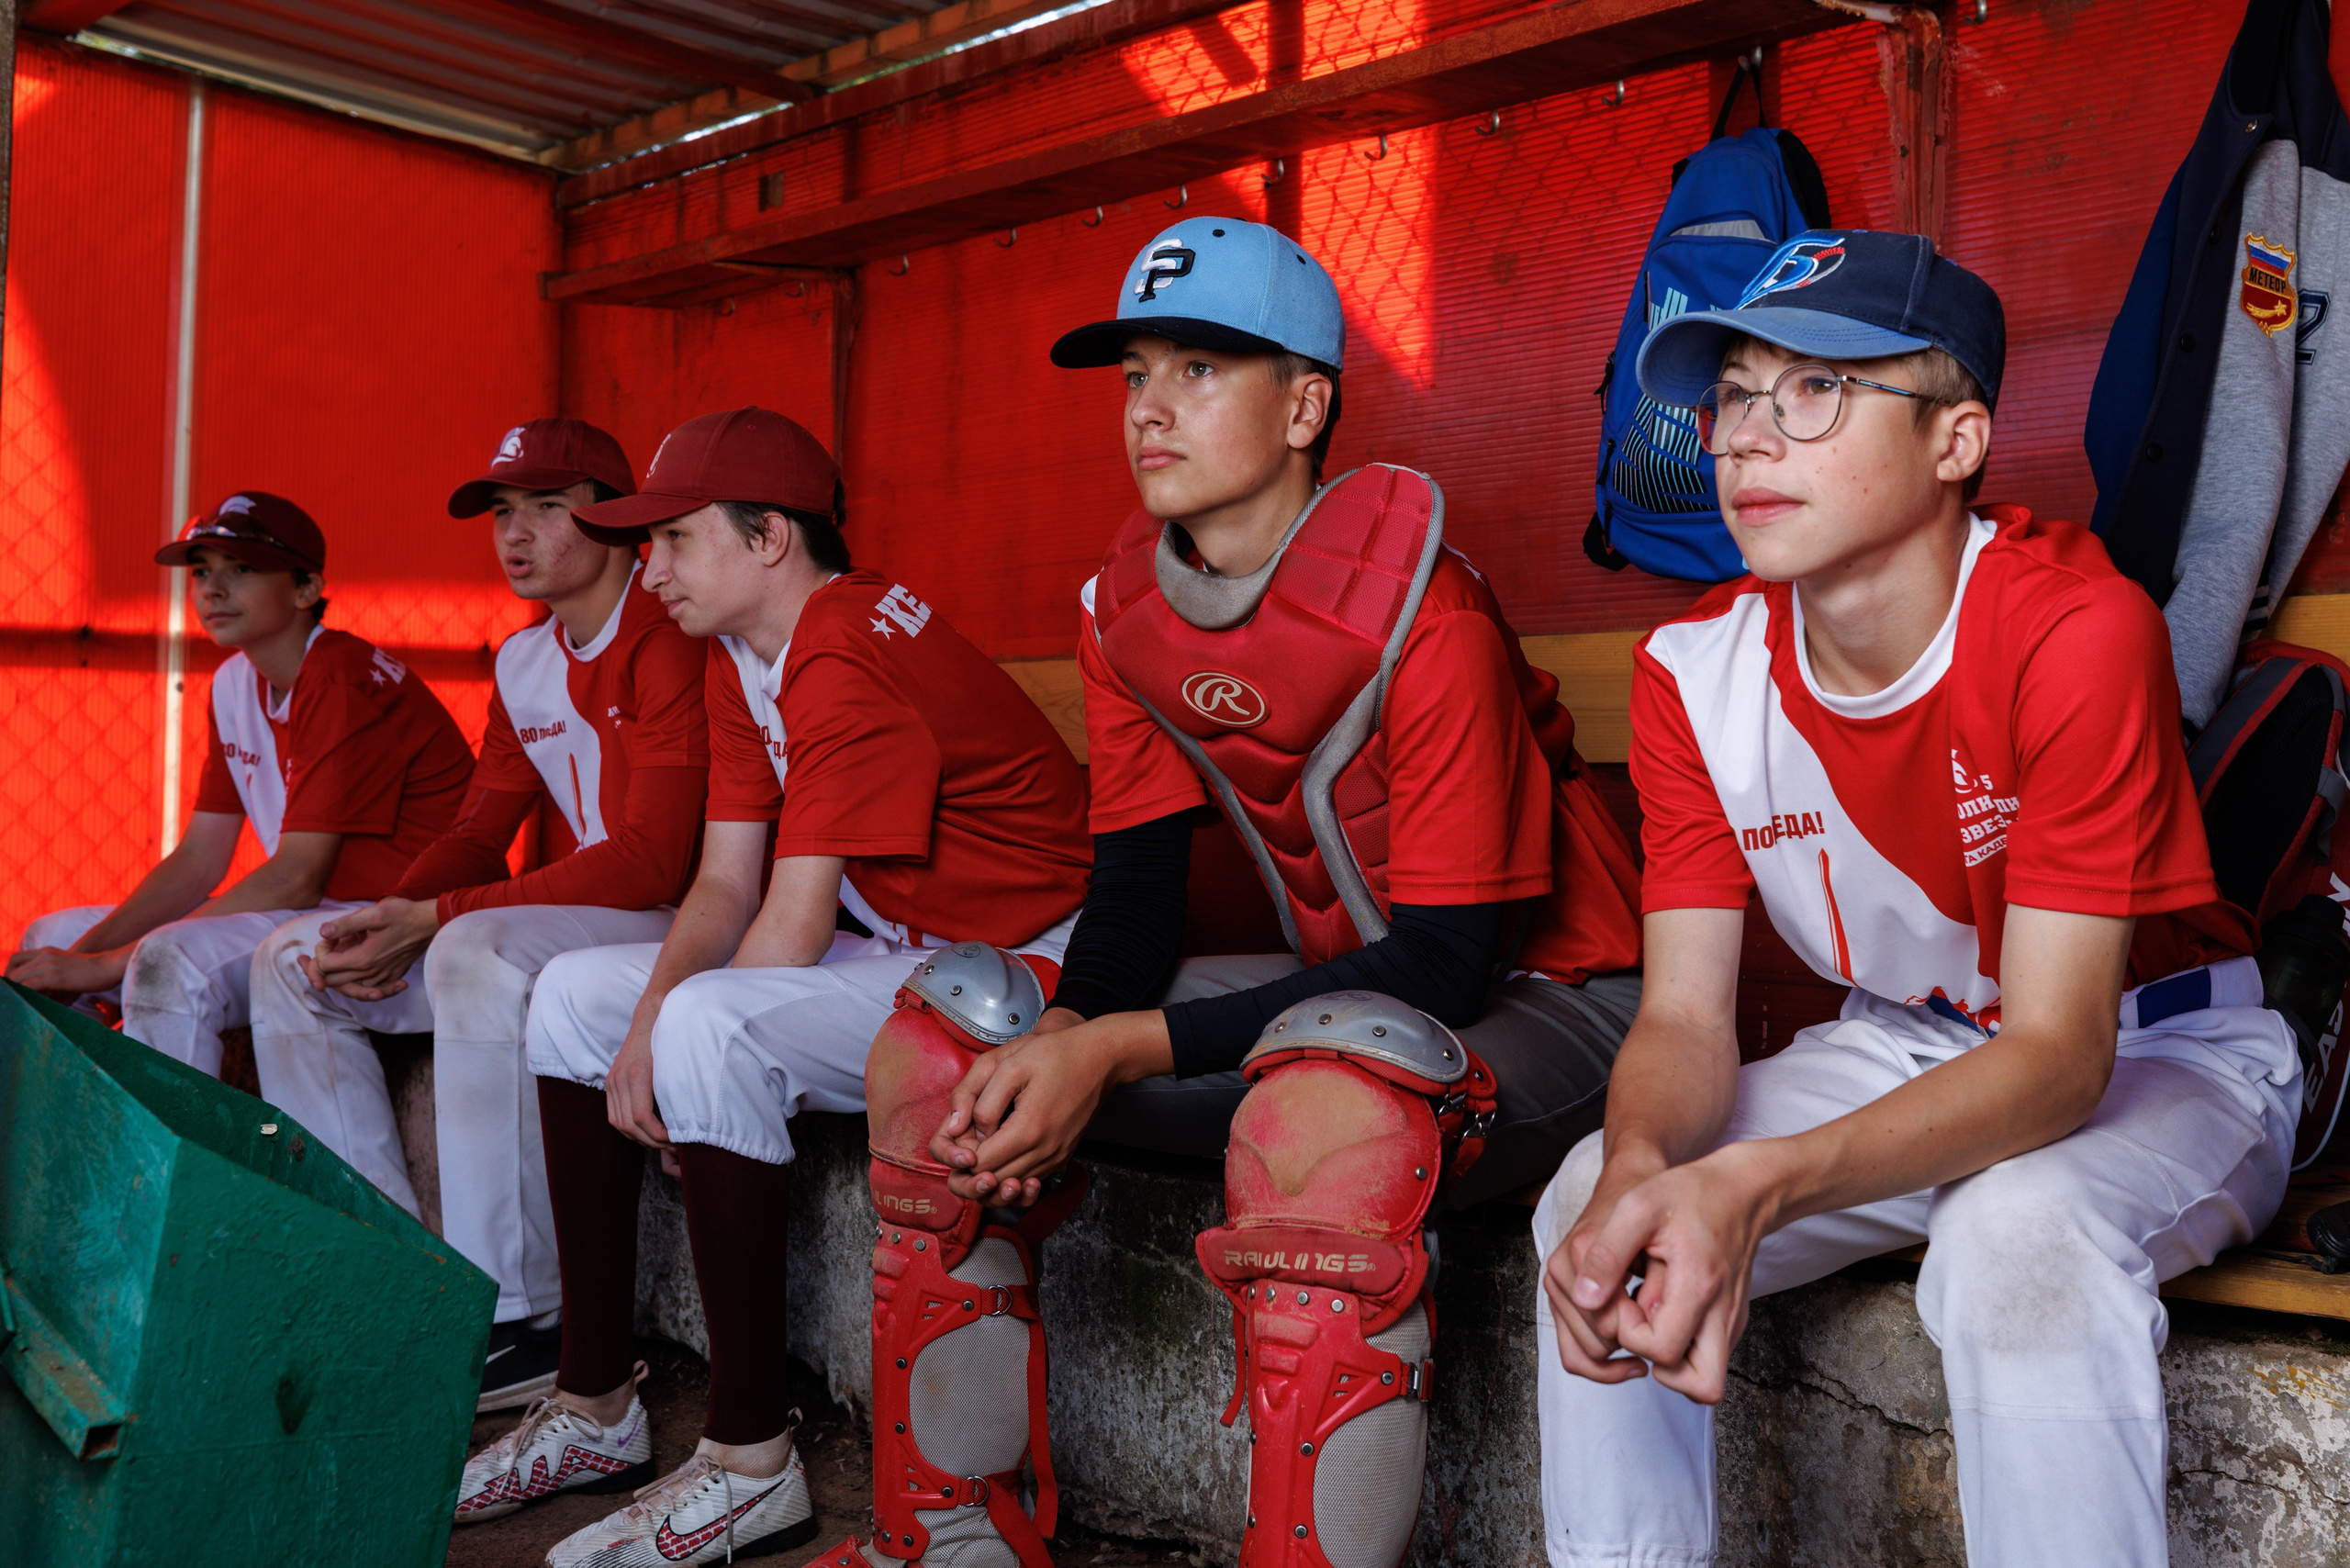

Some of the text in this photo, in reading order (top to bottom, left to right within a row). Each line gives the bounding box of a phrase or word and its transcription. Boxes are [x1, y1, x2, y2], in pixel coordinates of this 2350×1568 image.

[2249, 266, 2287, 295] МЕТЕОР
[874, 583, 933, 638] КЕ
[519, 726, 539, 745] 80
[1741, 811, 1826, 851] ПОЕДА!
[1960, 813, 2013, 844] ЗВЕЗ
